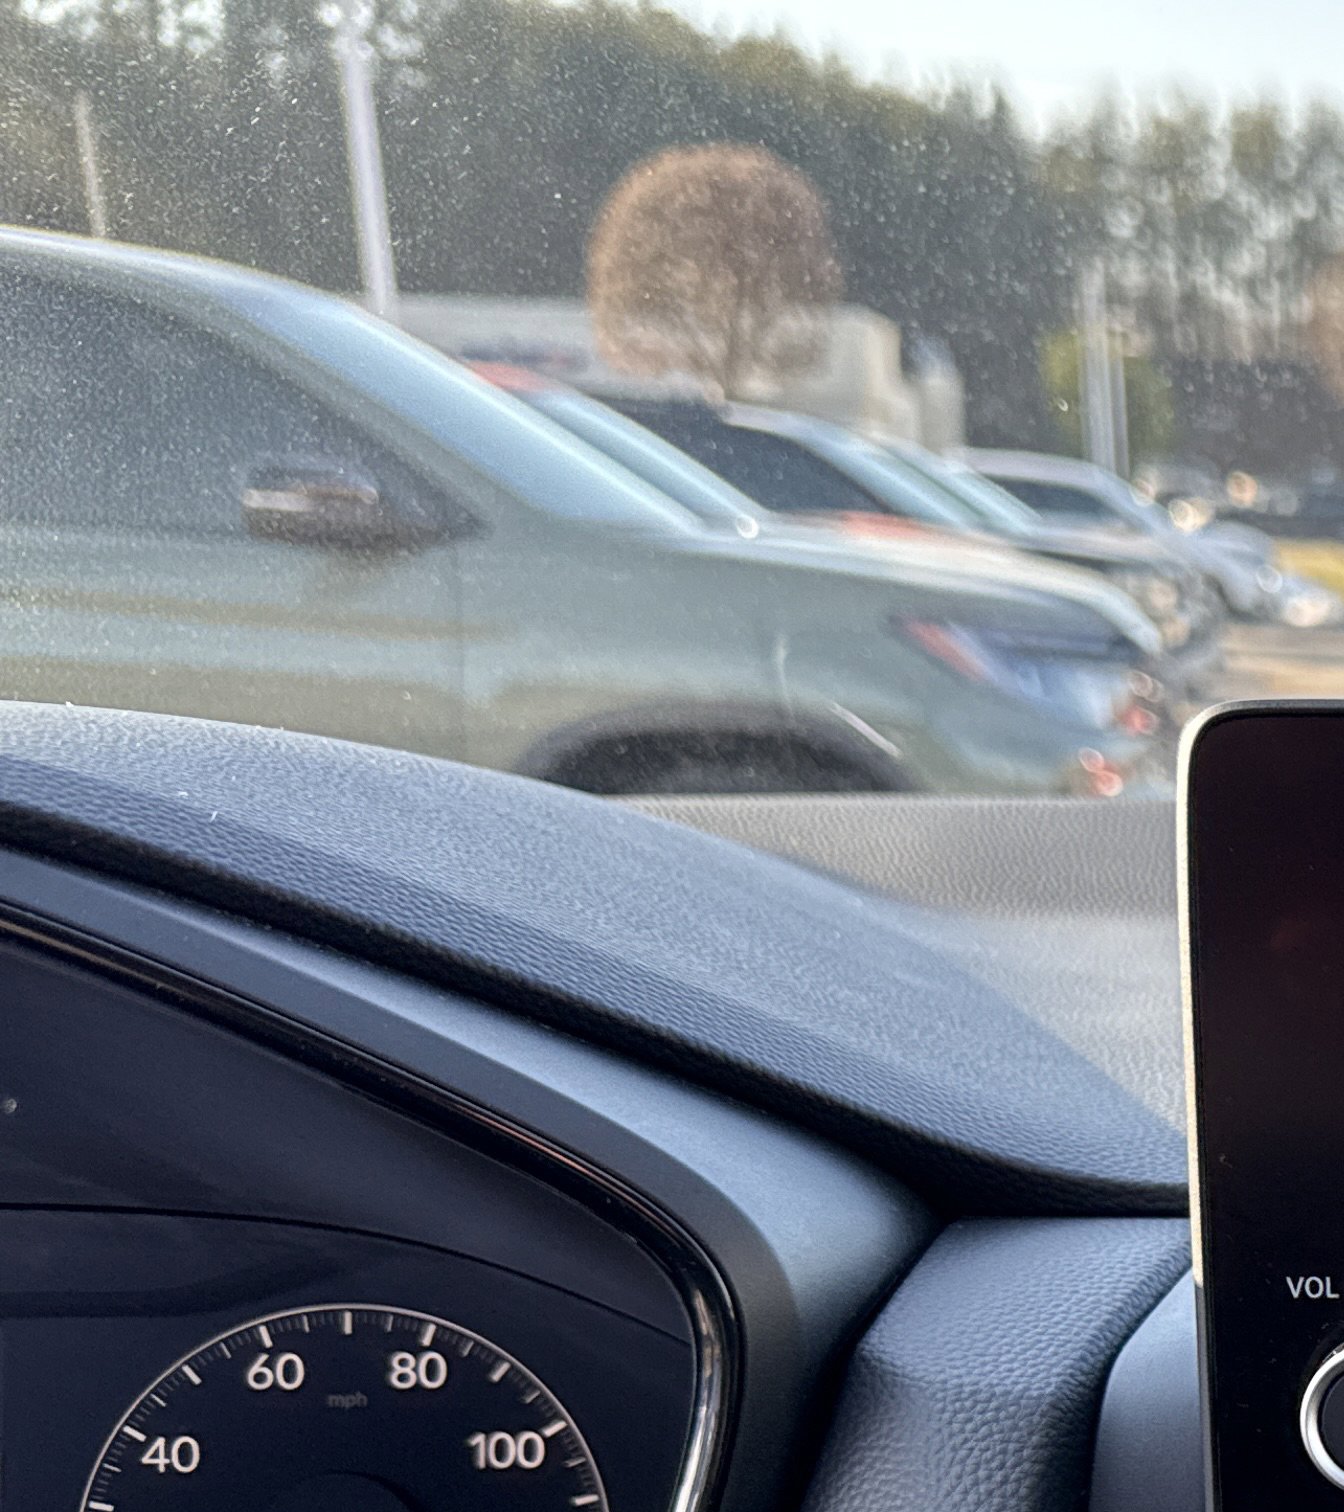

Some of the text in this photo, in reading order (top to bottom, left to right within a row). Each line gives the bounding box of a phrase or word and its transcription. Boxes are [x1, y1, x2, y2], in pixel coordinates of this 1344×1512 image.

[1286, 1275, 1340, 1299] VOL
[247, 1352, 305, 1390] 60
[389, 1351, 447, 1389] 80
[327, 1391, 368, 1409] mph
[141, 1436, 200, 1473] 40
[469, 1431, 545, 1469] 100
